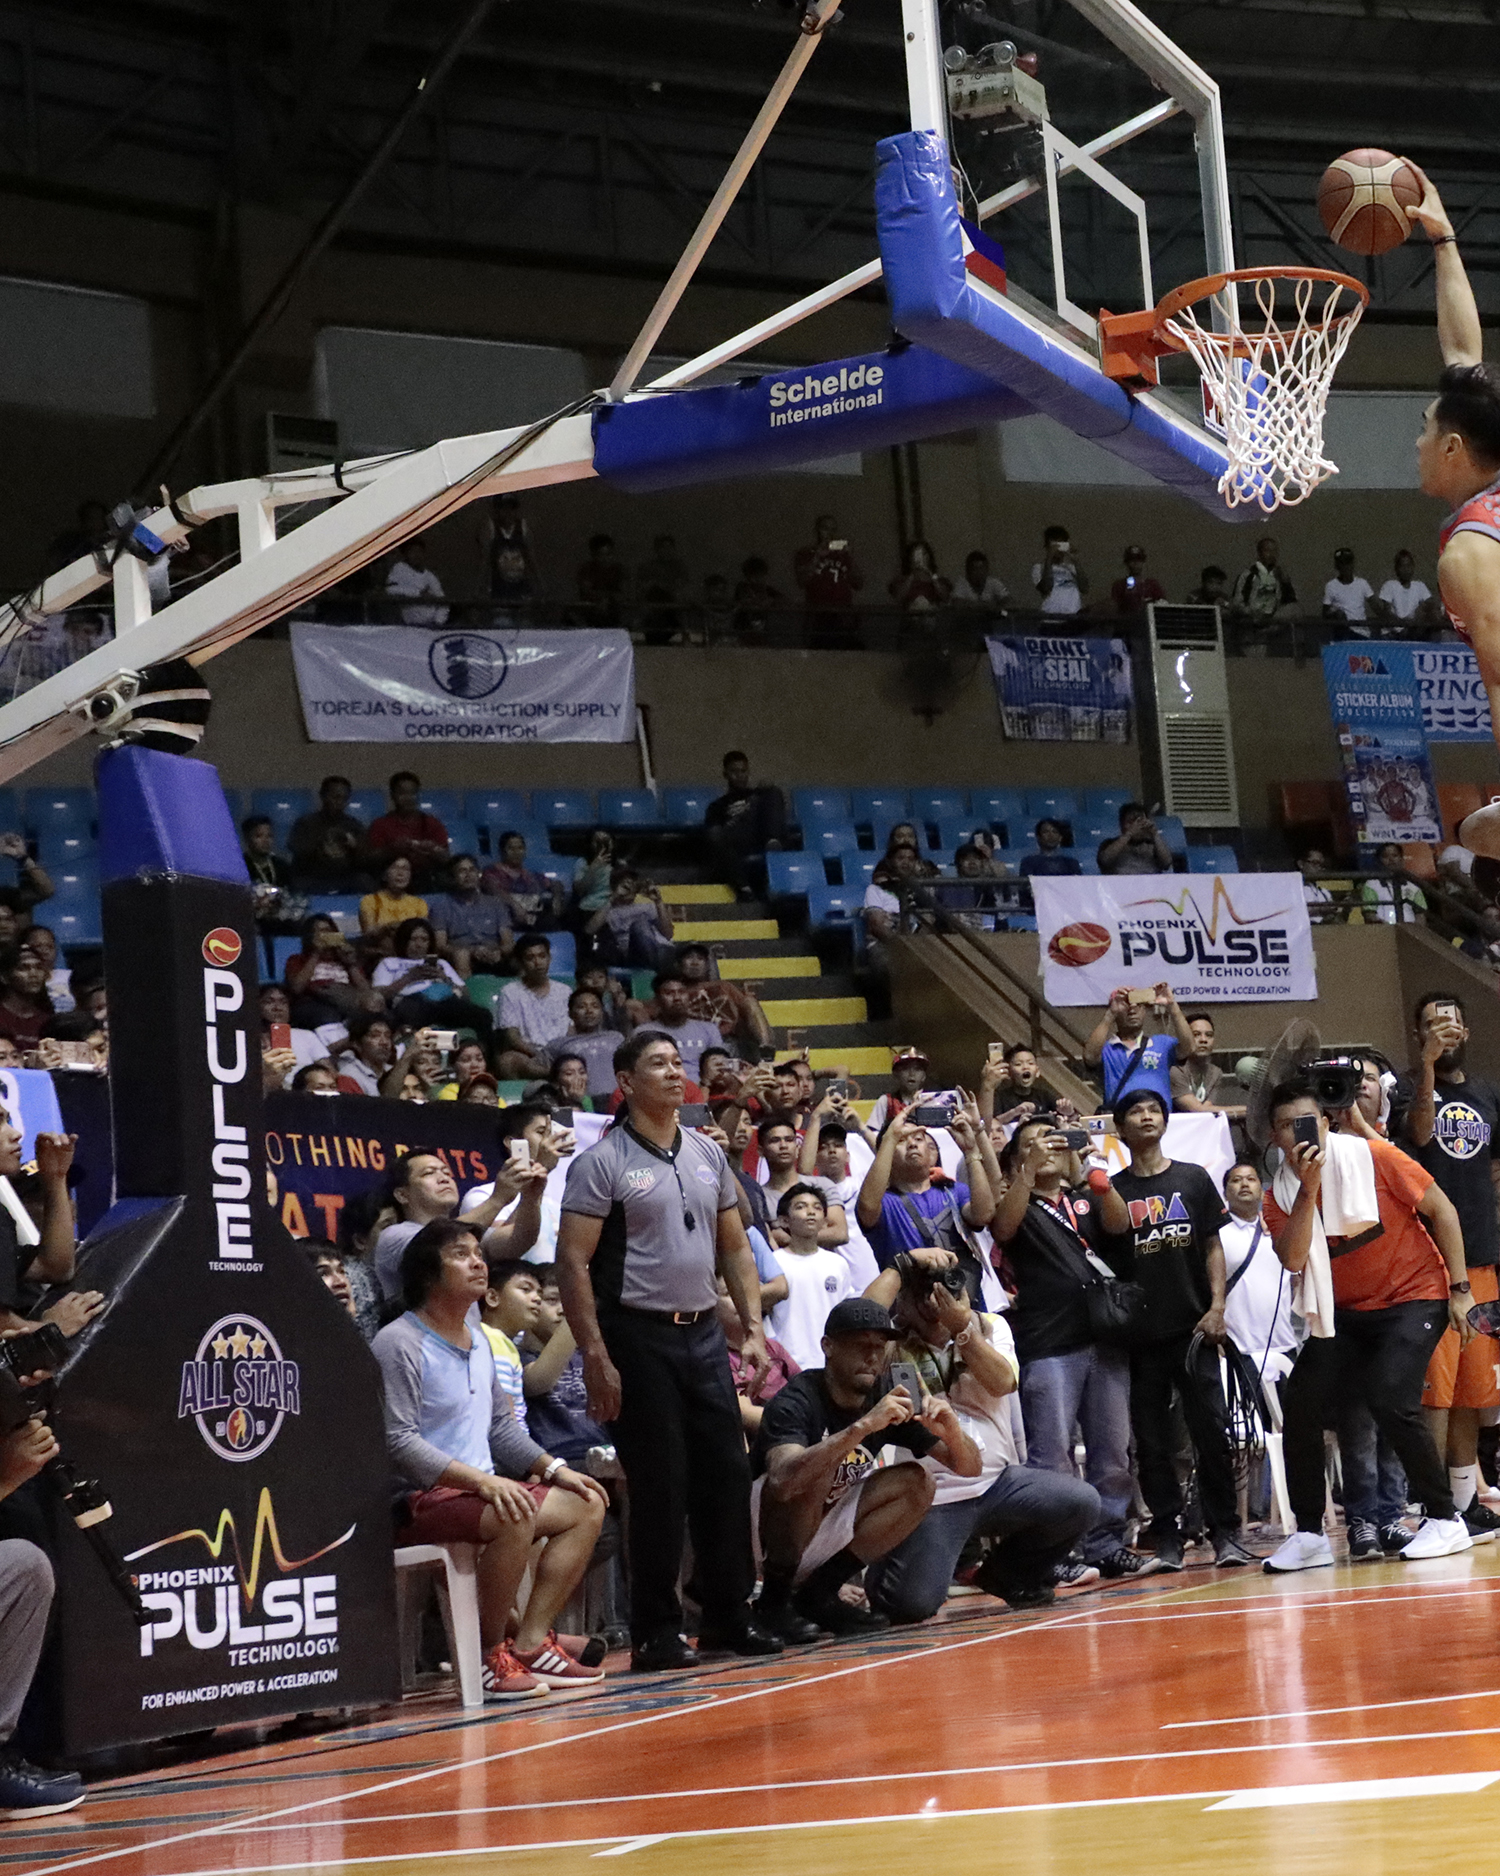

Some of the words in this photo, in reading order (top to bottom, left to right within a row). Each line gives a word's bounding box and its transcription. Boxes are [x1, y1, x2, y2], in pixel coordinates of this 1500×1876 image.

[769, 364, 884, 407] Schelde
[770, 388, 883, 427] International
[1045, 659, 1091, 682] SEAL
[1416, 653, 1480, 675] URE
[313, 700, 402, 716] TOREJA'S
[407, 702, 549, 718] CONSTRUCTION
[553, 703, 621, 718] SUPPLY
[1336, 692, 1379, 708] STICKER
[1379, 692, 1414, 708] ALBUM
[1338, 707, 1415, 718] COLLECTION
[405, 723, 538, 739] CORPORATION
[1118, 919, 1197, 930] PHOENIX
[1119, 929, 1290, 967] PULSE
[1197, 967, 1290, 978] TECHNOLOGY
[1192, 985, 1221, 996] POWER
[1222, 986, 1229, 995] &
[1231, 984, 1291, 995] ACCELERATION
[203, 967, 254, 1259] PULSE
[1430, 1116, 1456, 1138] ALL
[1457, 1119, 1492, 1146] STAR
[265, 1131, 386, 1172] OTHING
[628, 1168, 651, 1180] TAG
[1128, 1192, 1190, 1229] PBA
[1134, 1223, 1192, 1246] LARO
[208, 1261, 264, 1272] TECHNOLOGY
[178, 1361, 231, 1419] ALL
[234, 1360, 300, 1416] STAR
[138, 1565, 236, 1591] PHOENIX
[139, 1574, 339, 1657] PULSE
[228, 1637, 338, 1667] TECHNOLOGY
[141, 1694, 164, 1710] FOR
[165, 1686, 220, 1707] ENHANCED
[220, 1681, 256, 1698] POWER
[257, 1679, 265, 1693] &
[267, 1668, 339, 1692] ACCELERATION
